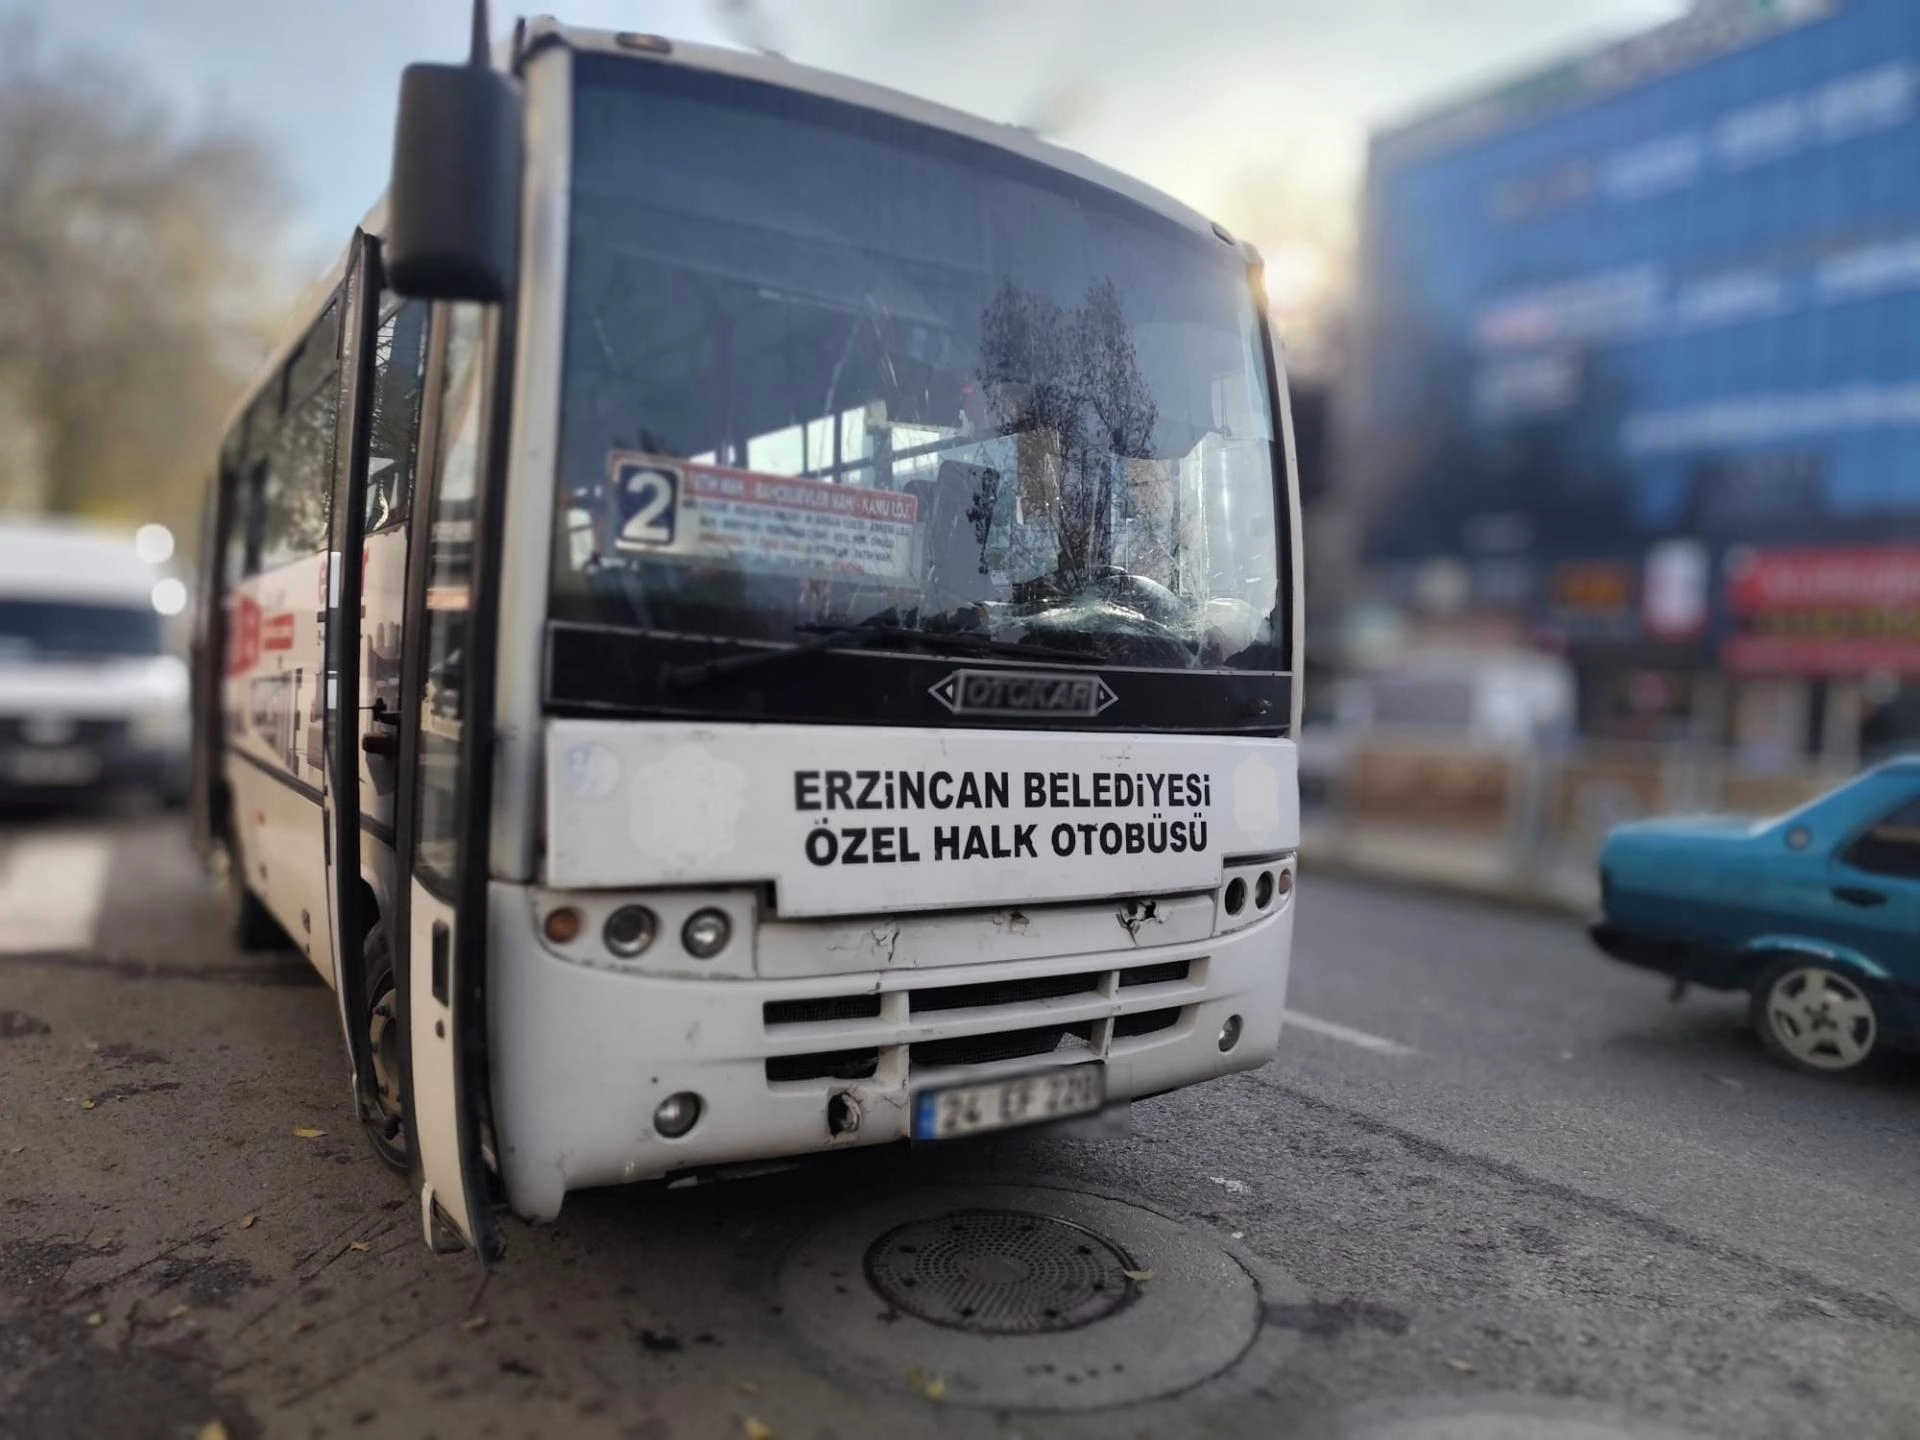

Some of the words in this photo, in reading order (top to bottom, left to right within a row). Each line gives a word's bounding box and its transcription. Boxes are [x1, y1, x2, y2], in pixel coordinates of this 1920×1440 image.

[622, 471, 672, 541] 2
[805, 817, 921, 866] ÖZEL
[933, 823, 1038, 861] HALK
[1051, 812, 1208, 856] OTOBÜSÜ
